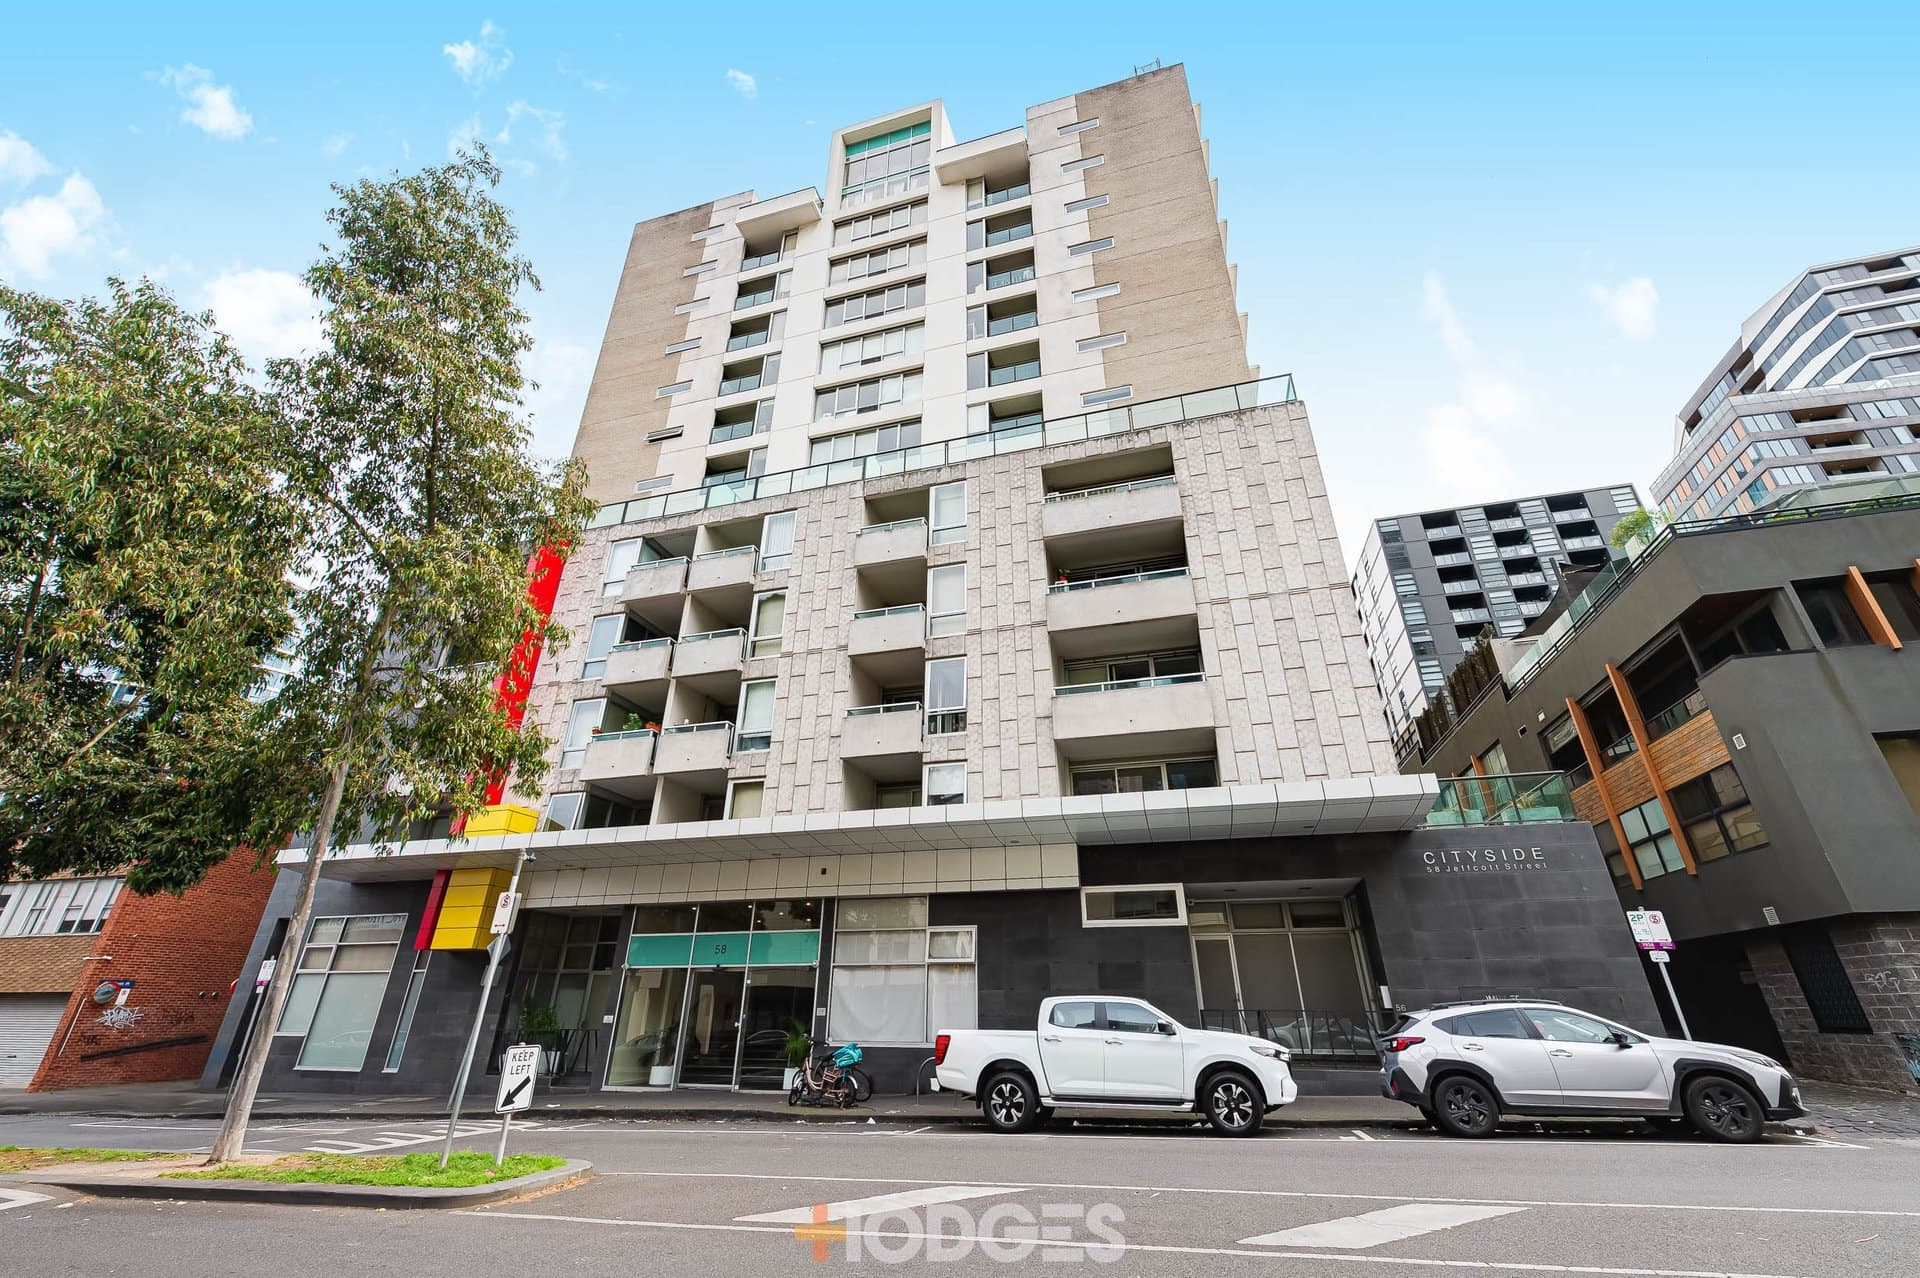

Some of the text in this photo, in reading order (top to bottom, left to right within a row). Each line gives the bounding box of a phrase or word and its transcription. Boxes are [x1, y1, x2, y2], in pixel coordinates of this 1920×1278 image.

[1423, 847, 1545, 864] CITYSIDE
[1445, 864, 1500, 873] Jeffcott
[1504, 862, 1548, 871] Street
[1629, 914, 1644, 922] 2P
[714, 944, 727, 955] 58
[1395, 1004, 1407, 1012] 56
[511, 1051, 535, 1063] KEEP
[510, 1064, 532, 1076] LEFT
